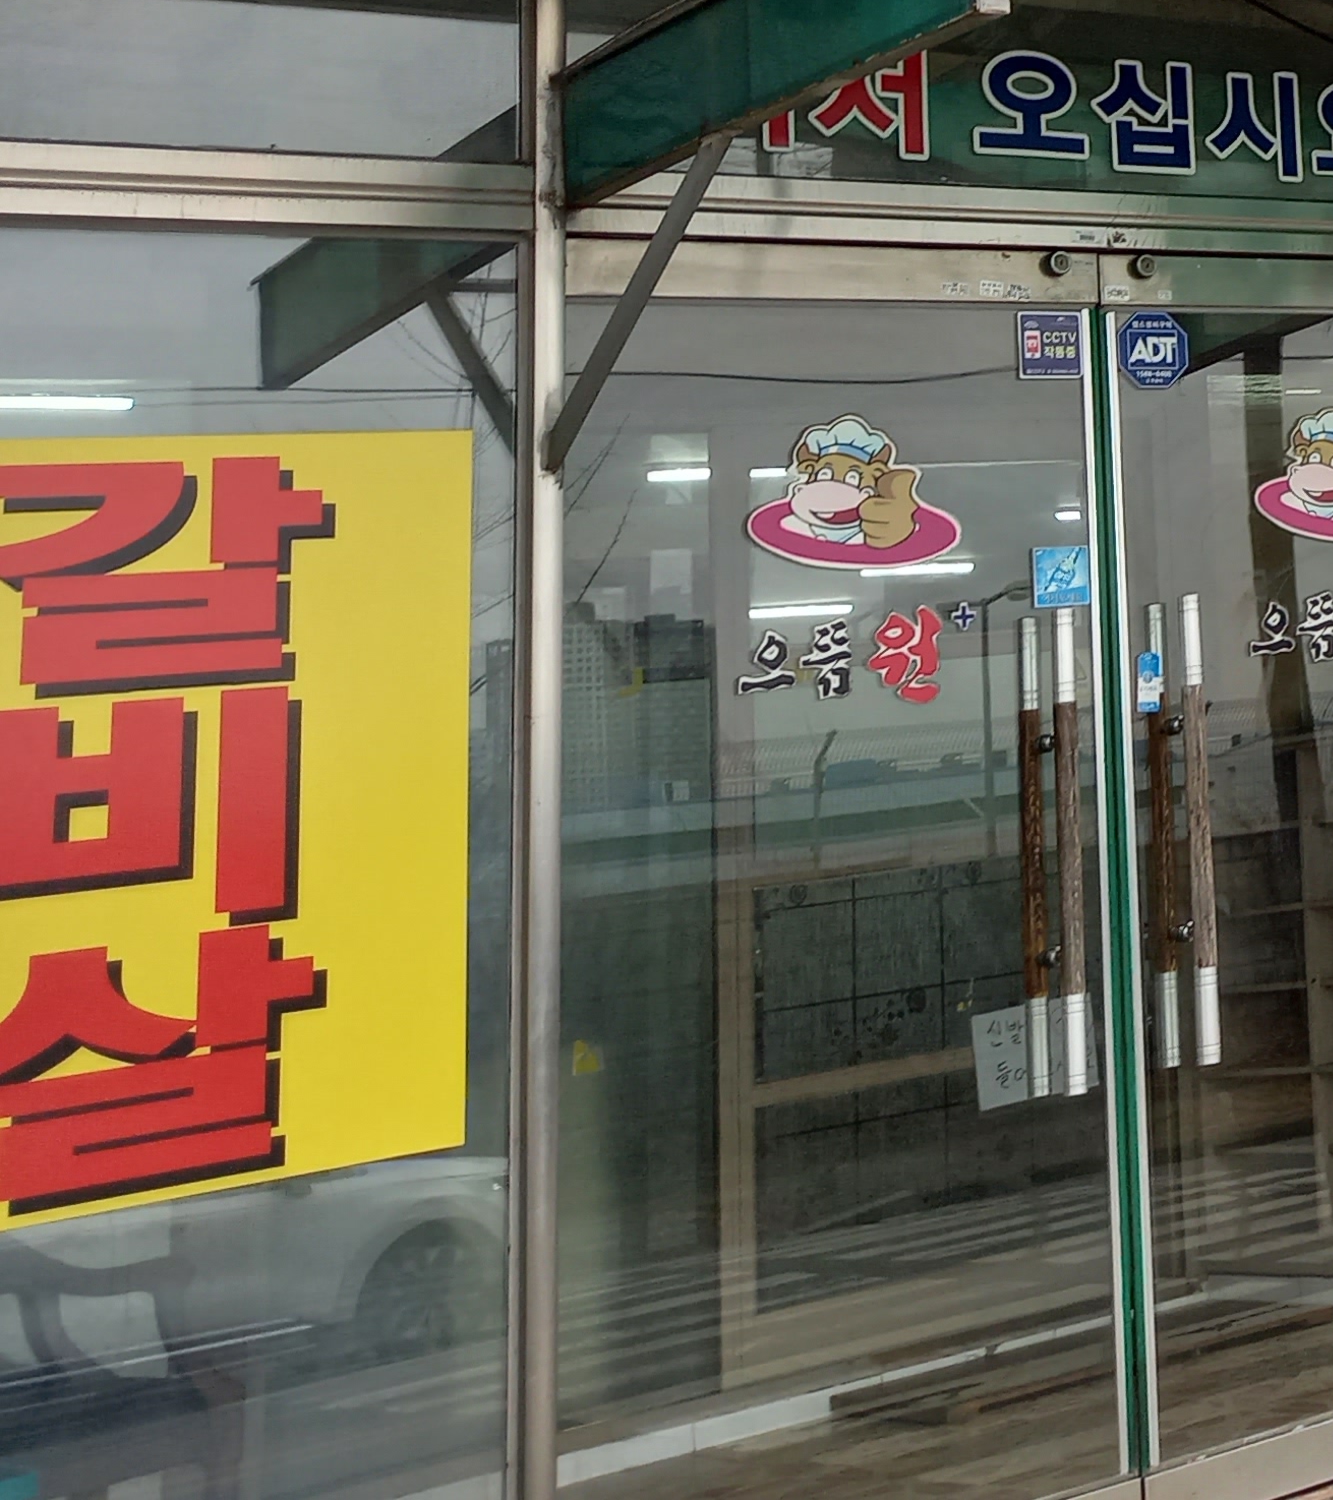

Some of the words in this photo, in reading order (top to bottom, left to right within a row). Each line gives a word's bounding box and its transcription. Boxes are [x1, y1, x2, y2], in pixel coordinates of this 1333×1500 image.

[762, 49, 930, 162] 서
[1043, 331, 1077, 344] CCTV
[1128, 336, 1178, 364] ADT
[0, 455, 336, 1218] 갈비살
